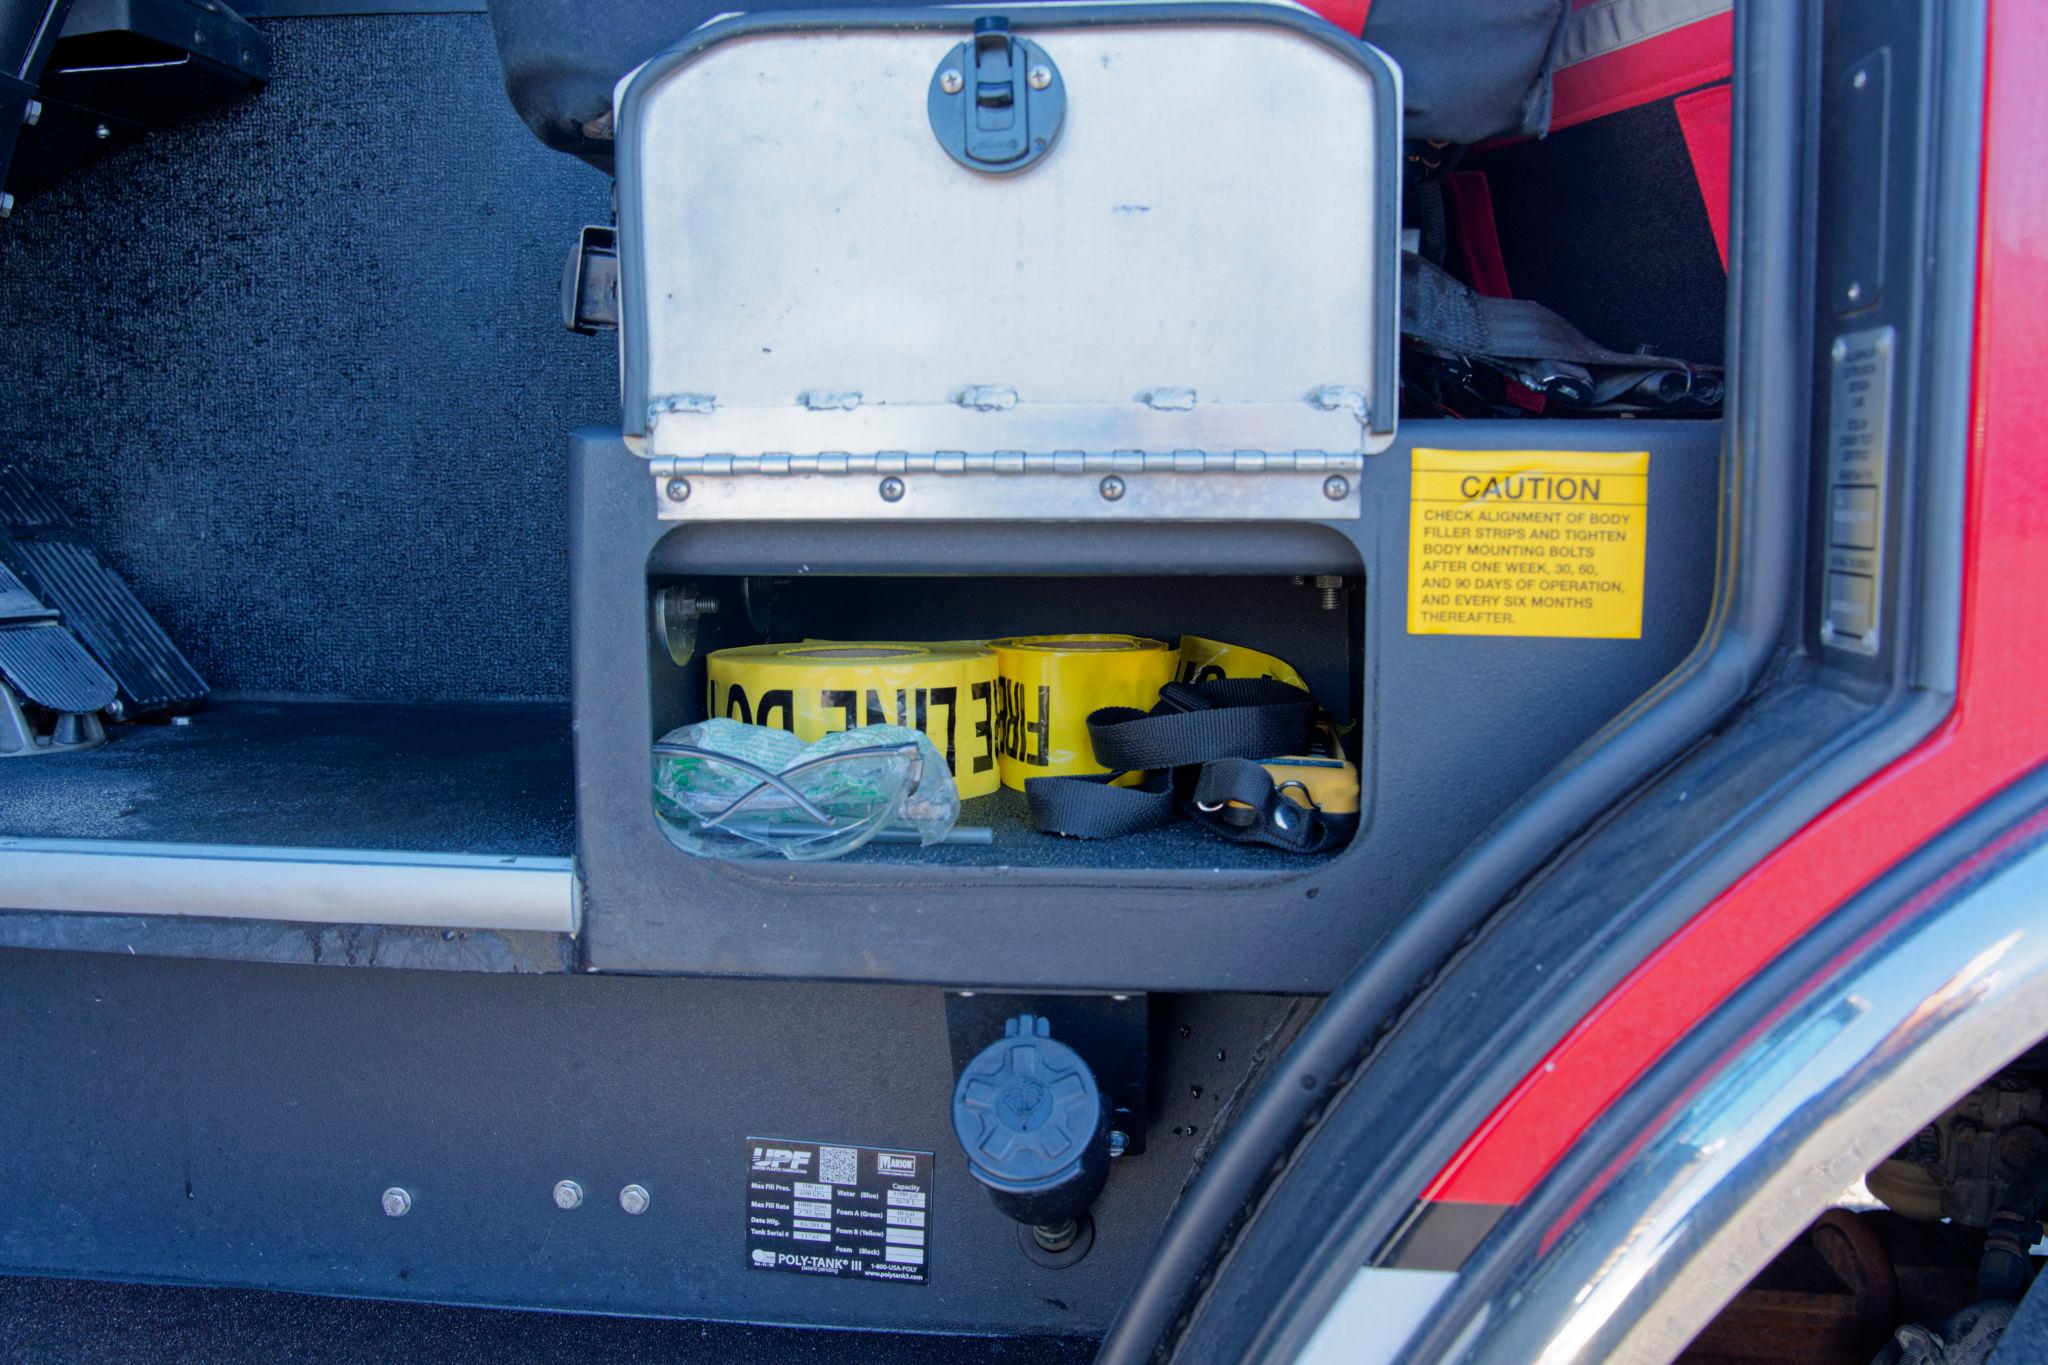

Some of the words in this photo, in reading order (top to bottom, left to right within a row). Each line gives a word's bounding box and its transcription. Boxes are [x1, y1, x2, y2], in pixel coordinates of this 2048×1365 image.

[1460, 476, 1601, 501] CAUTION
[1424, 509, 1474, 522] CHECK
[1478, 510, 1561, 524] ALIGNMENT
[1566, 512, 1584, 524] OF
[1590, 513, 1630, 525] BODY
[1424, 526, 1471, 538] FILLER
[1475, 527, 1526, 539] STRIPS
[1529, 529, 1560, 540] AND
[1565, 530, 1626, 541] TIGHTEN
[1423, 544, 1462, 556] BODY
[1467, 545, 1545, 557] MOUNTING
[1549, 546, 1595, 558] BOLTS
[1422, 561, 1467, 572] AFTER
[1471, 562, 1500, 574] ONE
[1506, 563, 1551, 575] WEEK,
[1555, 564, 1575, 575] 30,
[1579, 564, 1598, 576] 60,
[1422, 578, 1451, 589] AND
[1456, 578, 1470, 590] 90
[1474, 579, 1512, 590] DAYS
[1516, 579, 1535, 591] OF
[1539, 580, 1625, 594] OPERATION,
[1421, 594, 1450, 605] AND
[1455, 595, 1500, 606] EVERY
[1504, 596, 1526, 607] SIX
[1531, 597, 1594, 608] MONTHS
[1421, 611, 1516, 623] THEREAFTER.
[892, 1183, 920, 1193] Capacity
[860, 1211, 883, 1219] (Green)
[860, 1230, 884, 1238] (Yellow)
[859, 1248, 880, 1256] (Black)
[851, 1260, 862, 1271] III
[871, 1263, 917, 1273] 1-800-USA-POLY
[864, 1270, 923, 1281] www.polytank3.com
